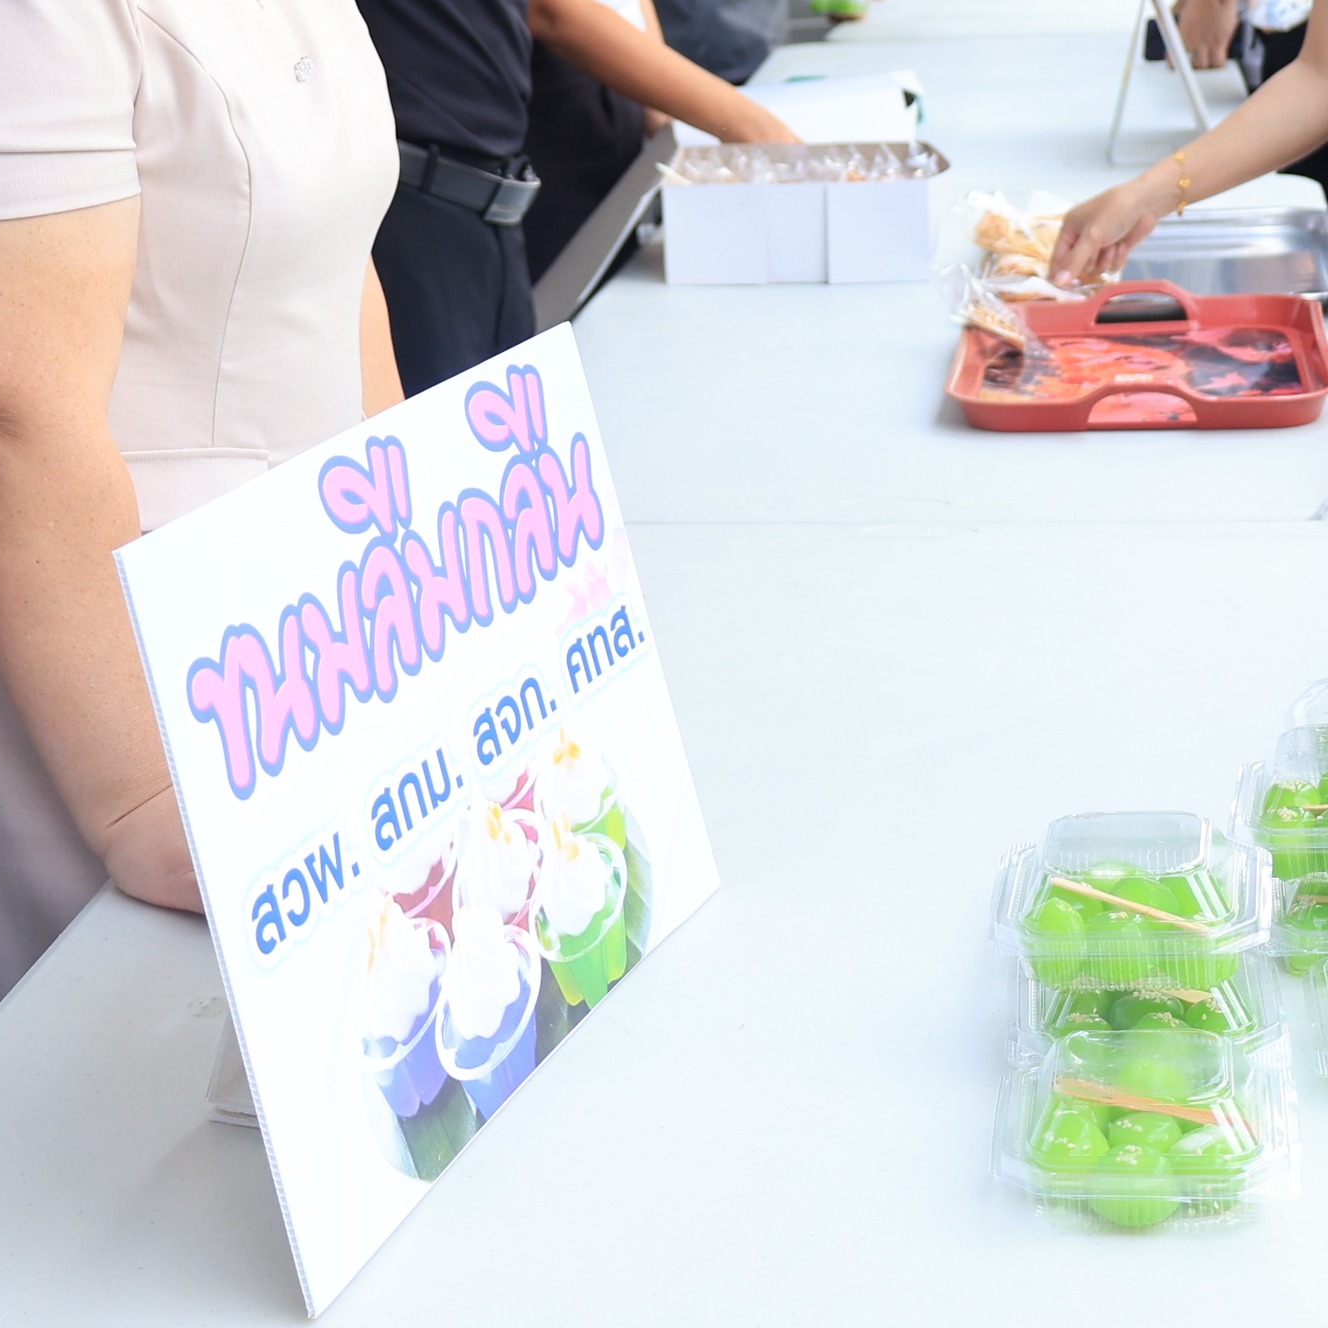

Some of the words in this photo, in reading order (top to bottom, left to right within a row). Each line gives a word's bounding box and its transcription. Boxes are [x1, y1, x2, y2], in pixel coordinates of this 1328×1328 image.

[186, 364, 604, 801] ขนมลืมกลืน
[371, 747, 463, 851] สกม.
[473, 677, 557, 766] สจก.
[566, 605, 645, 694] ศทส.
